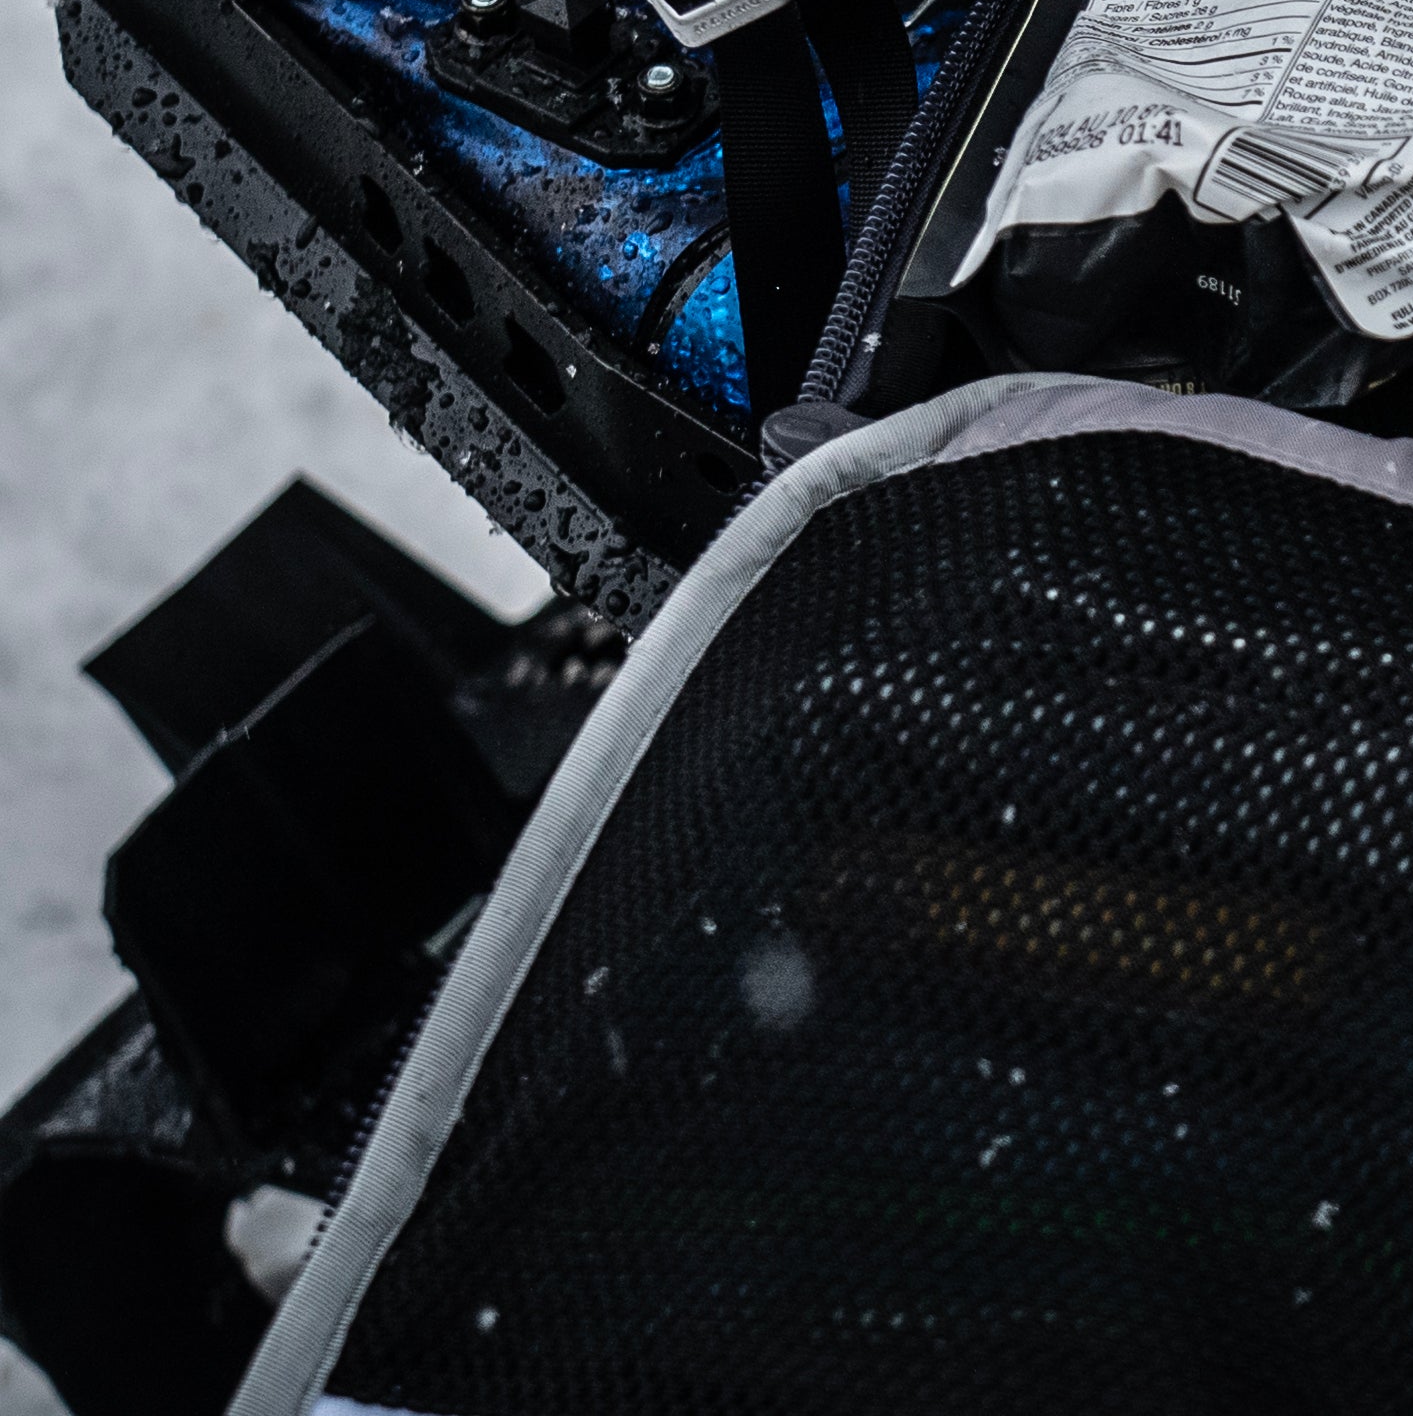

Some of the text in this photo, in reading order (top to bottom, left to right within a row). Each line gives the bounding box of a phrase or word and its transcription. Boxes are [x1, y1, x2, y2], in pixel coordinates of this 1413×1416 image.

[1349, 58, 1390, 74] Acide
[1281, 87, 1327, 104] Rouge
[1118, 119, 1184, 147] 01:41
[1364, 191, 1401, 226] CANADA
